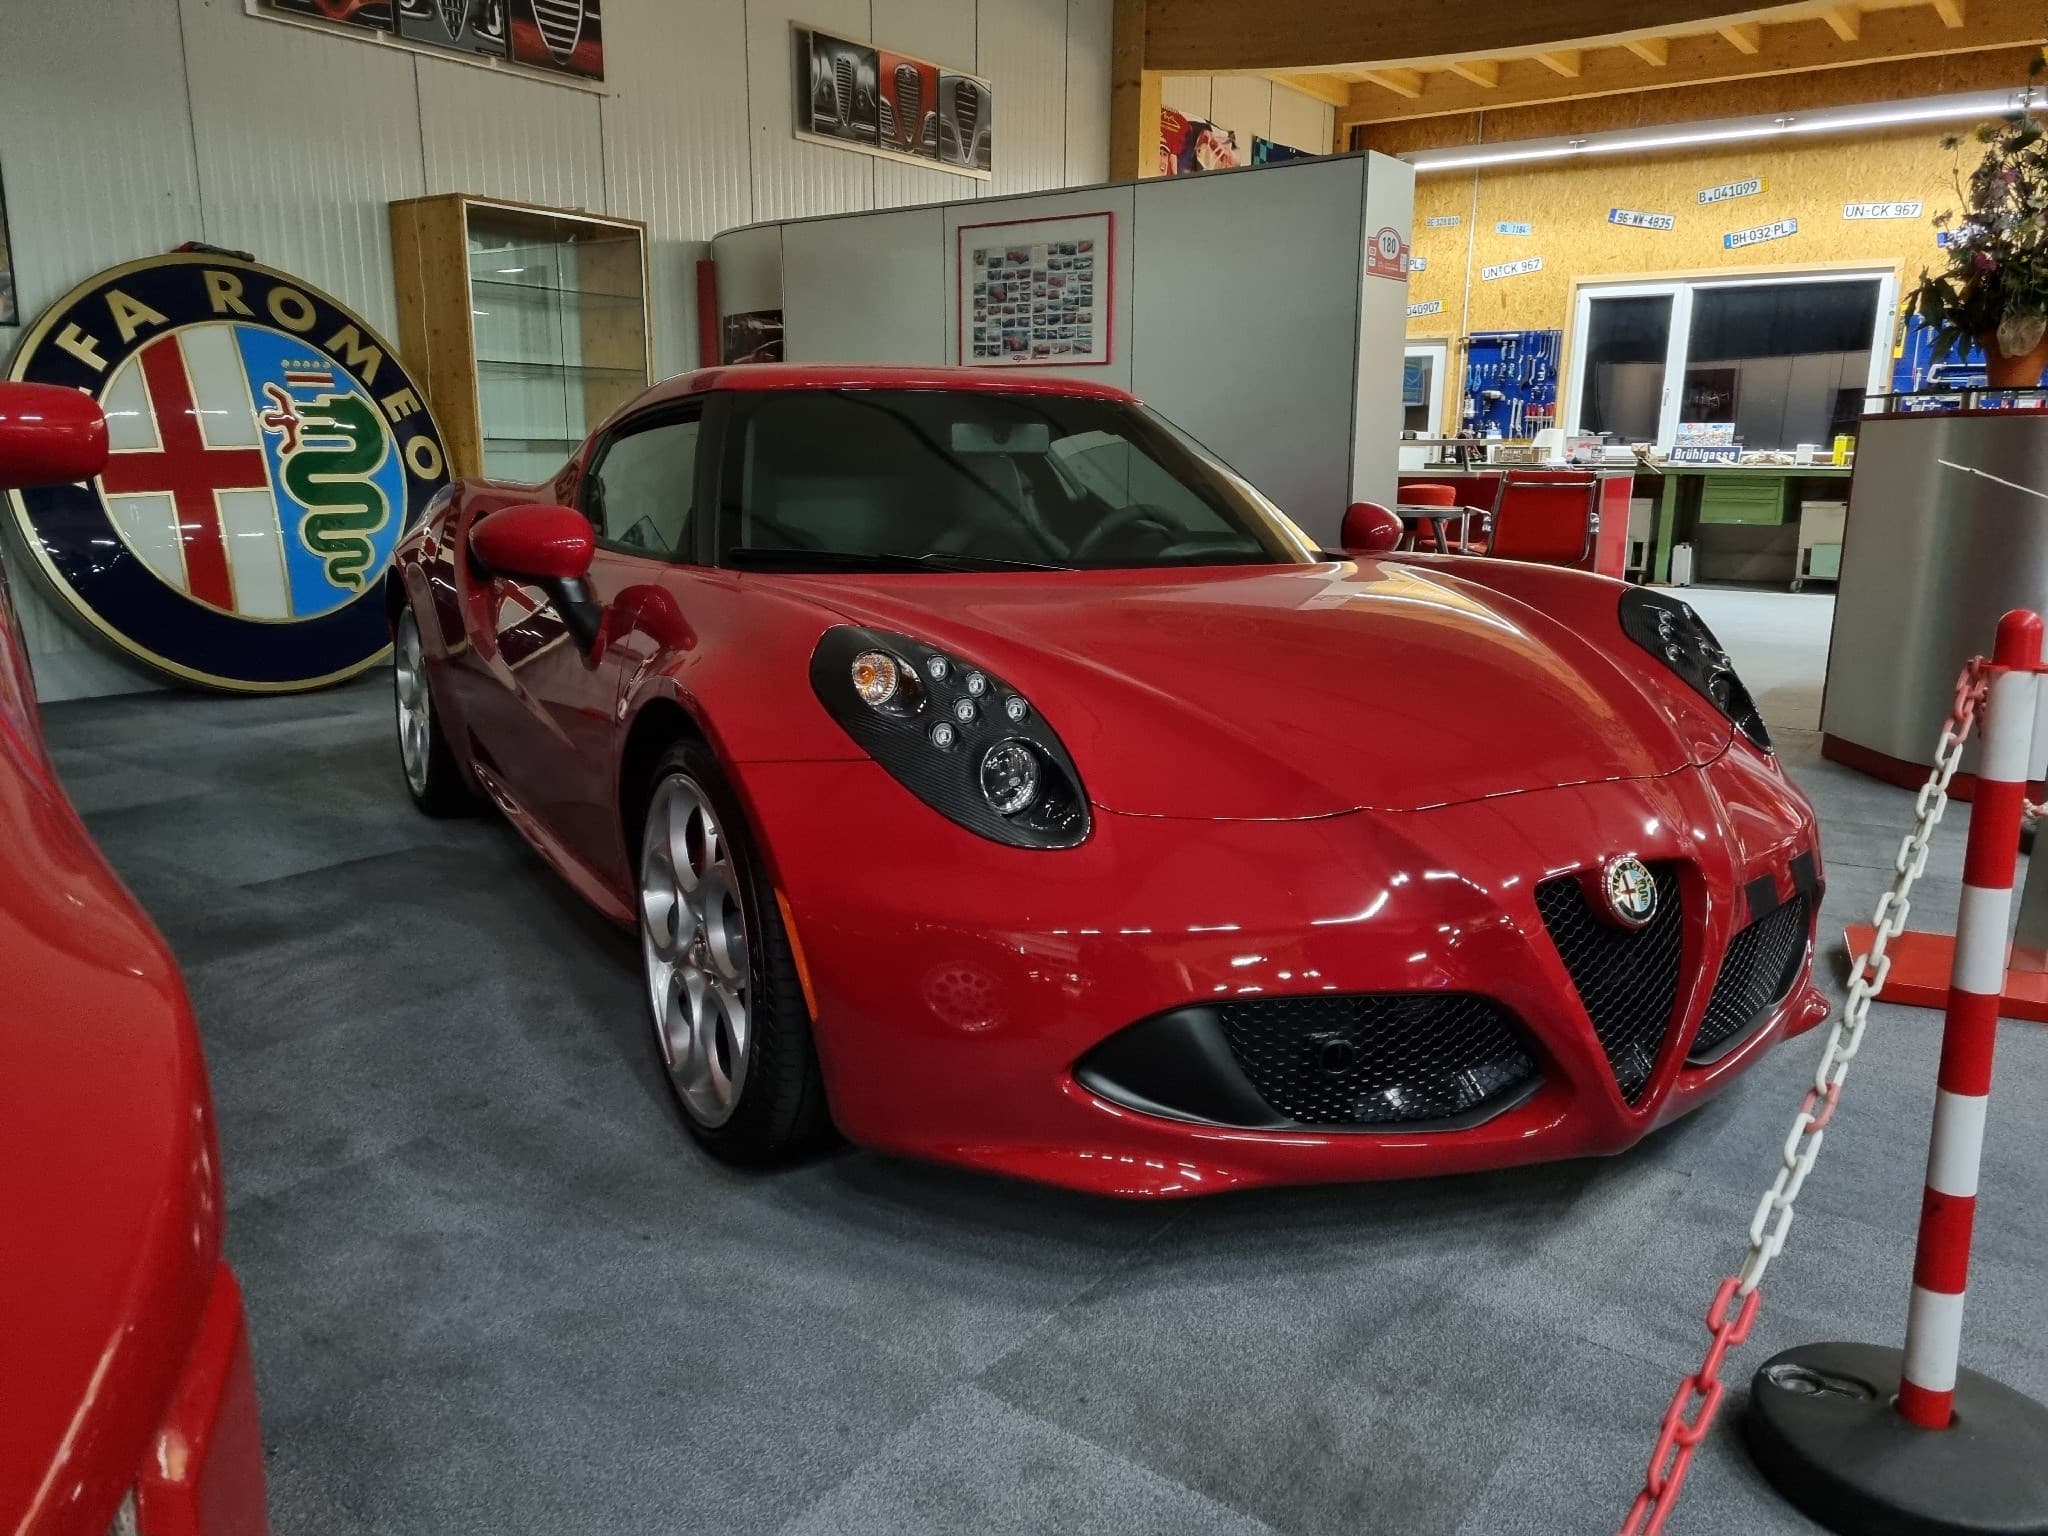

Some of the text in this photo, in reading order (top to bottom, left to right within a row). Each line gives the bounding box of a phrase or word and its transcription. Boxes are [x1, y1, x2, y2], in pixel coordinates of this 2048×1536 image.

[1713, 181, 1758, 200] 041099
[1845, 204, 1920, 217] UN-CK 967
[1732, 223, 1789, 245] BH 032 PL
[1383, 237, 1396, 254] 180
[1521, 259, 1540, 271] 967
[203, 270, 443, 481] ROMEO
[1674, 447, 1737, 463] Brühlgasse
